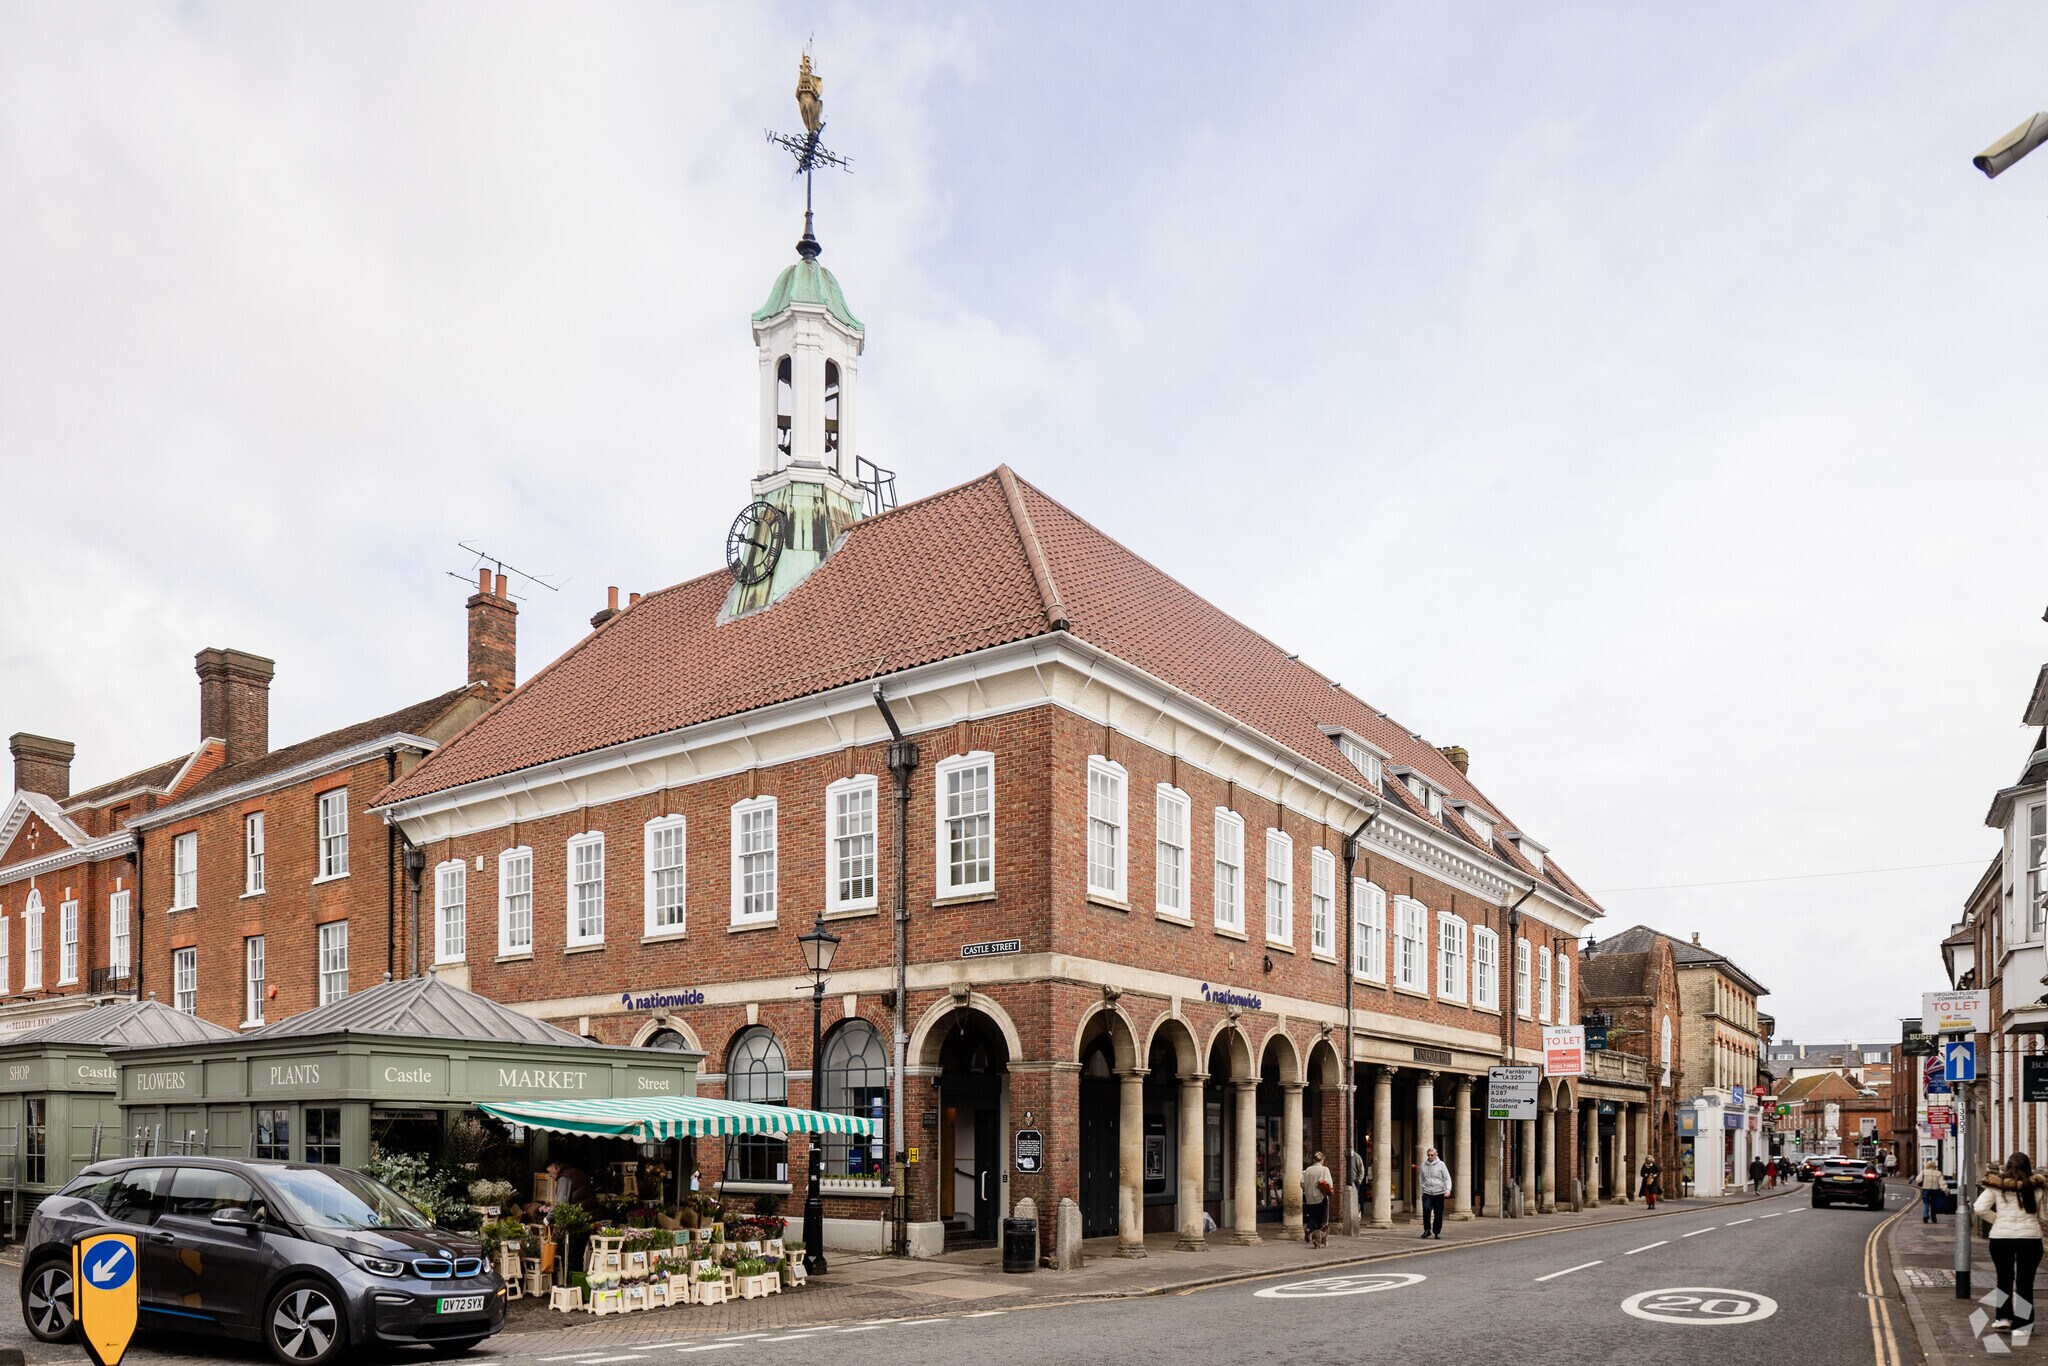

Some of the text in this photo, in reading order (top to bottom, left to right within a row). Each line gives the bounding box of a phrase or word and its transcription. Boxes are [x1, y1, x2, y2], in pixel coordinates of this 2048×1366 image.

[963, 942, 1018, 955] CASTLE STREET
[635, 989, 705, 1010] nationwide
[1211, 990, 1262, 1010] nationwide
[1932, 1000, 1980, 1012] TO LET
[1546, 1037, 1561, 1046] TO
[1563, 1036, 1582, 1045] LET
[1909, 1033, 1933, 1041] BUSH
[9, 1065, 30, 1081] SHOP
[77, 1065, 117, 1079] Castle
[270, 1064, 320, 1085] PLANTS
[384, 1066, 432, 1084] Castle
[498, 1068, 588, 1090] MARKET
[137, 1071, 186, 1091] FLOWERS
[637, 1076, 670, 1091] Street
[1284, 1280, 1396, 1290] 20
[443, 1297, 483, 1311] OV72 SYX
[1644, 1296, 1751, 1315] 20
